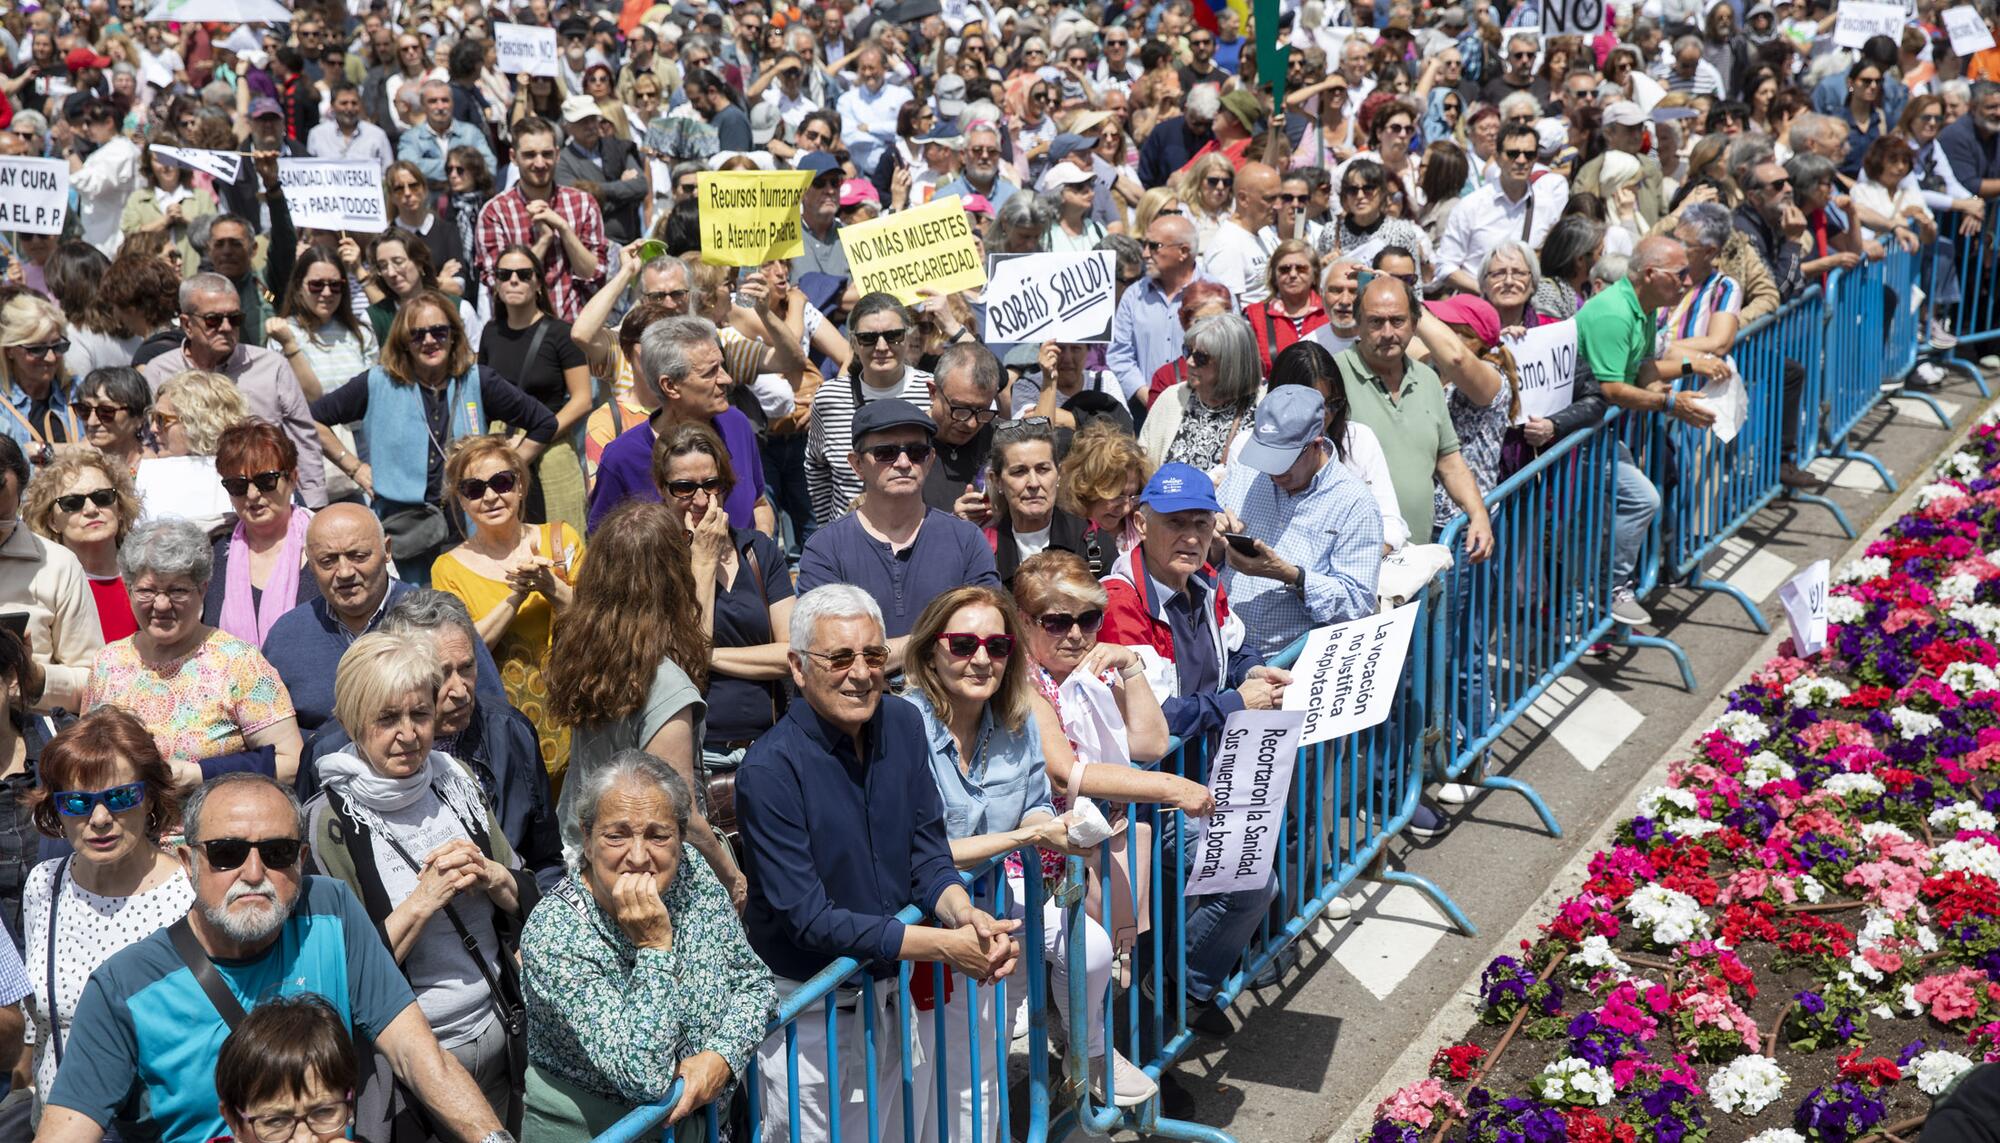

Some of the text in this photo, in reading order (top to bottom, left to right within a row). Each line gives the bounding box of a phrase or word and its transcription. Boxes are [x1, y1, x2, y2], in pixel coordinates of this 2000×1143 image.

[21, 169, 57, 191] CURA
[710, 182, 757, 208] Recursos
[13, 204, 31, 224] EL
[36, 207, 46, 225] P.
[51, 208, 61, 226] P.
[713, 223, 723, 249] la
[728, 221, 767, 249] Atención
[849, 214, 968, 265] NO MÁS MUERTES
[862, 248, 979, 294] POR PRECARIEDAD.
[1050, 252, 1112, 312] SALUD!
[1302, 626, 1349, 741] la explotación.
[1329, 633, 1365, 718] no justifica
[1353, 620, 1394, 716] La vocación
[1197, 728, 1249, 882] Sus muertos les botarán.
[1234, 728, 1288, 880] Recortaron la Sanidad.
